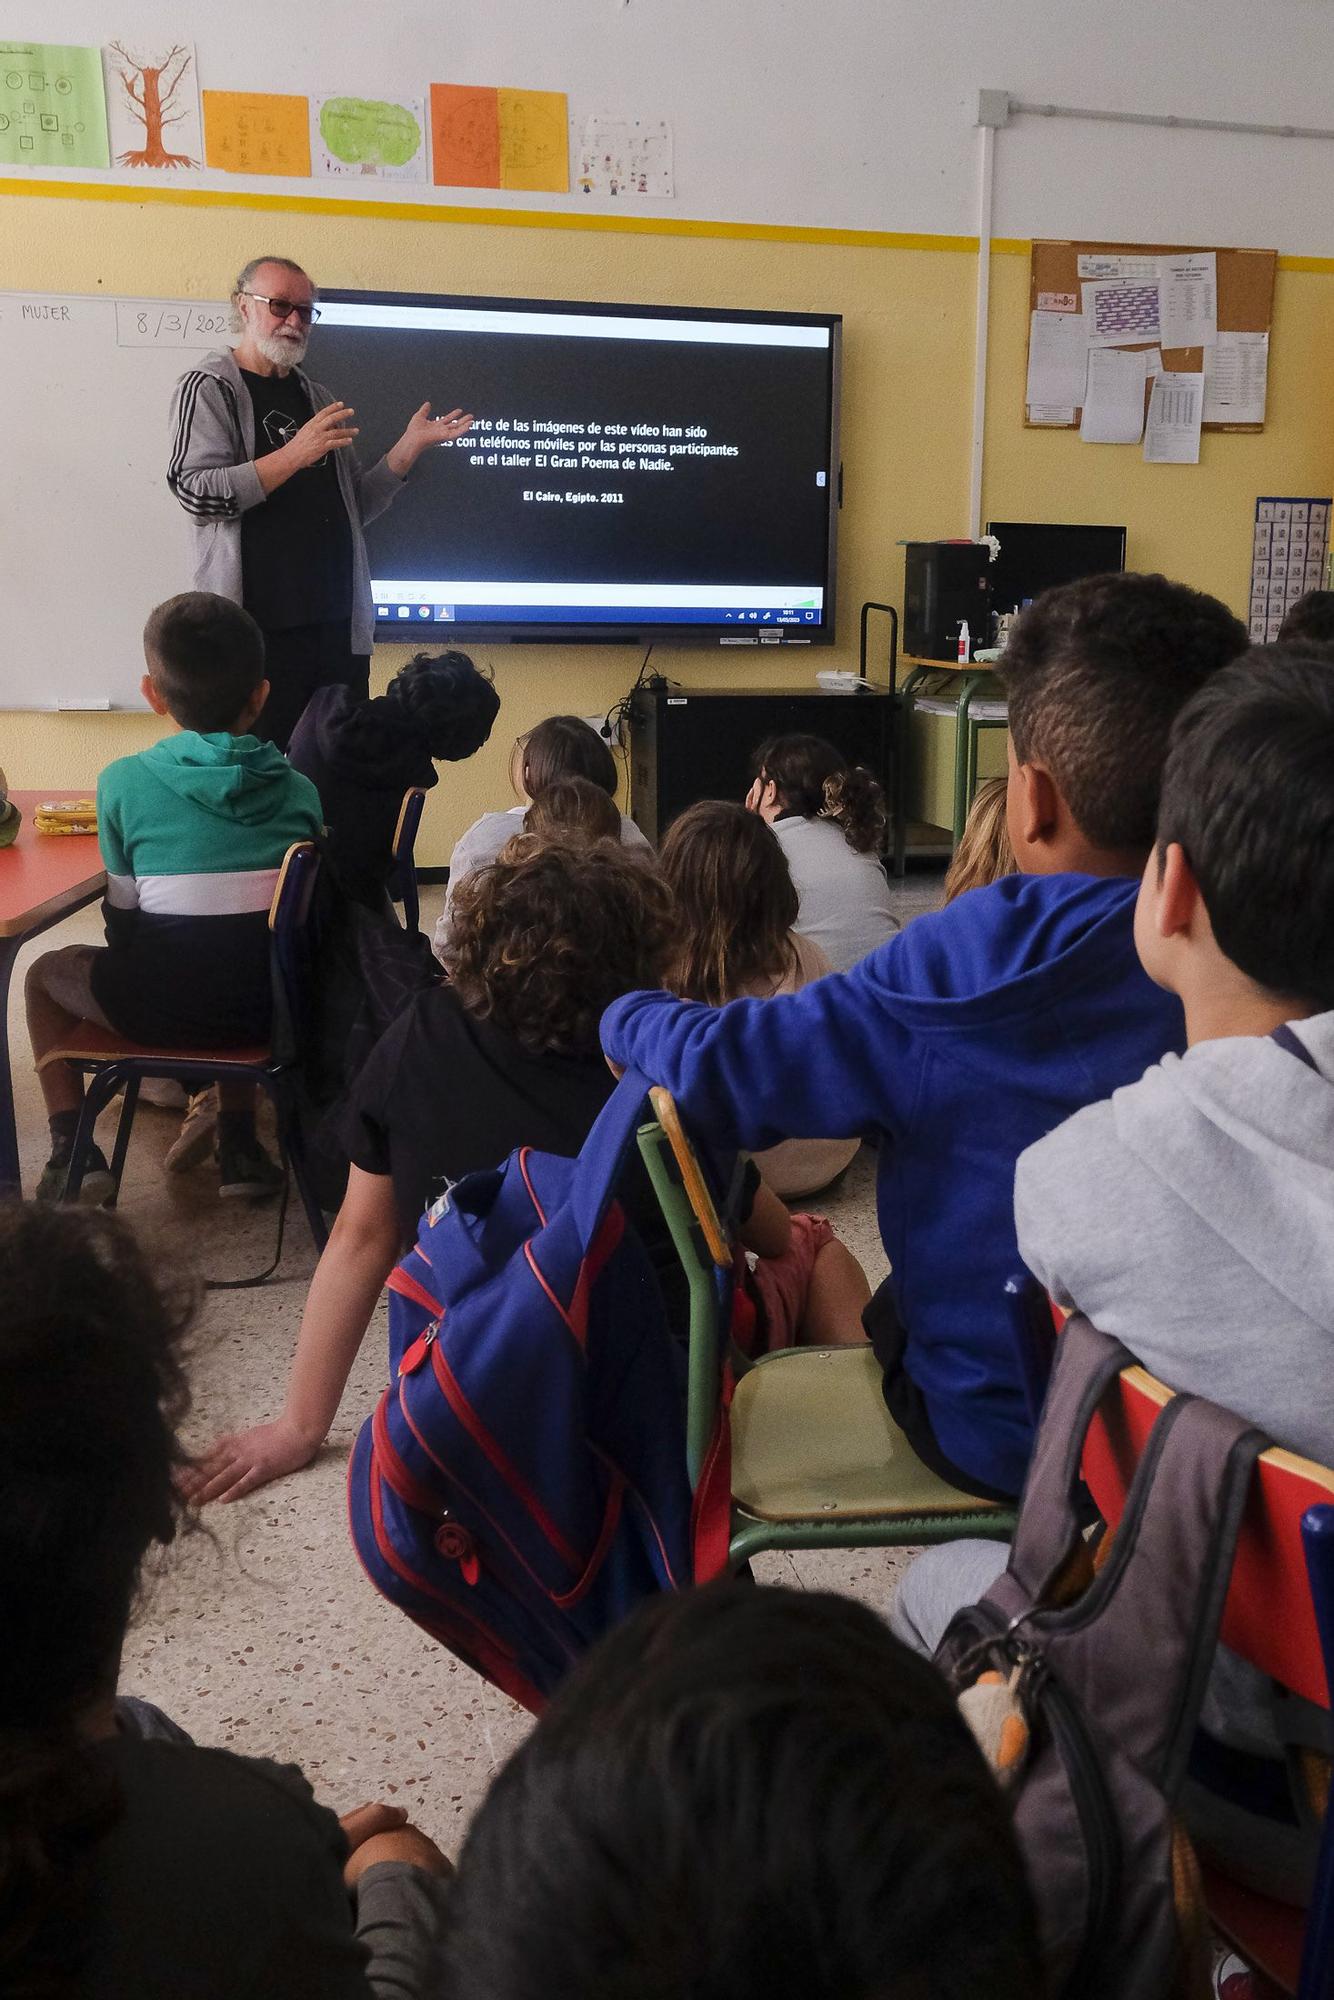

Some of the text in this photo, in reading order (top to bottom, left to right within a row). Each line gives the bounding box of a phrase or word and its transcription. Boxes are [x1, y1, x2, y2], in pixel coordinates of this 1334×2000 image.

[22, 305, 71, 321] MUJER
[136, 308, 230, 339] 8/3/202
[495, 419, 511, 431] de
[514, 419, 530, 432] las
[533, 420, 585, 436] imágenes
[587, 422, 601, 434] de
[604, 424, 628, 436] este
[631, 424, 660, 436] vídeo
[662, 425, 683, 438] han
[685, 426, 707, 439] sido
[456, 437, 476, 448] con
[480, 436, 531, 450] teléfonos
[534, 438, 576, 452] móviles
[578, 441, 598, 454] por
[600, 440, 616, 453] las
[619, 443, 667, 455] personas
[670, 443, 739, 458] participantes
[470, 453, 675, 471] en el taller El Gran Poema de Nadie.
[523, 491, 625, 504] El Cairo, Egipto. 2011
